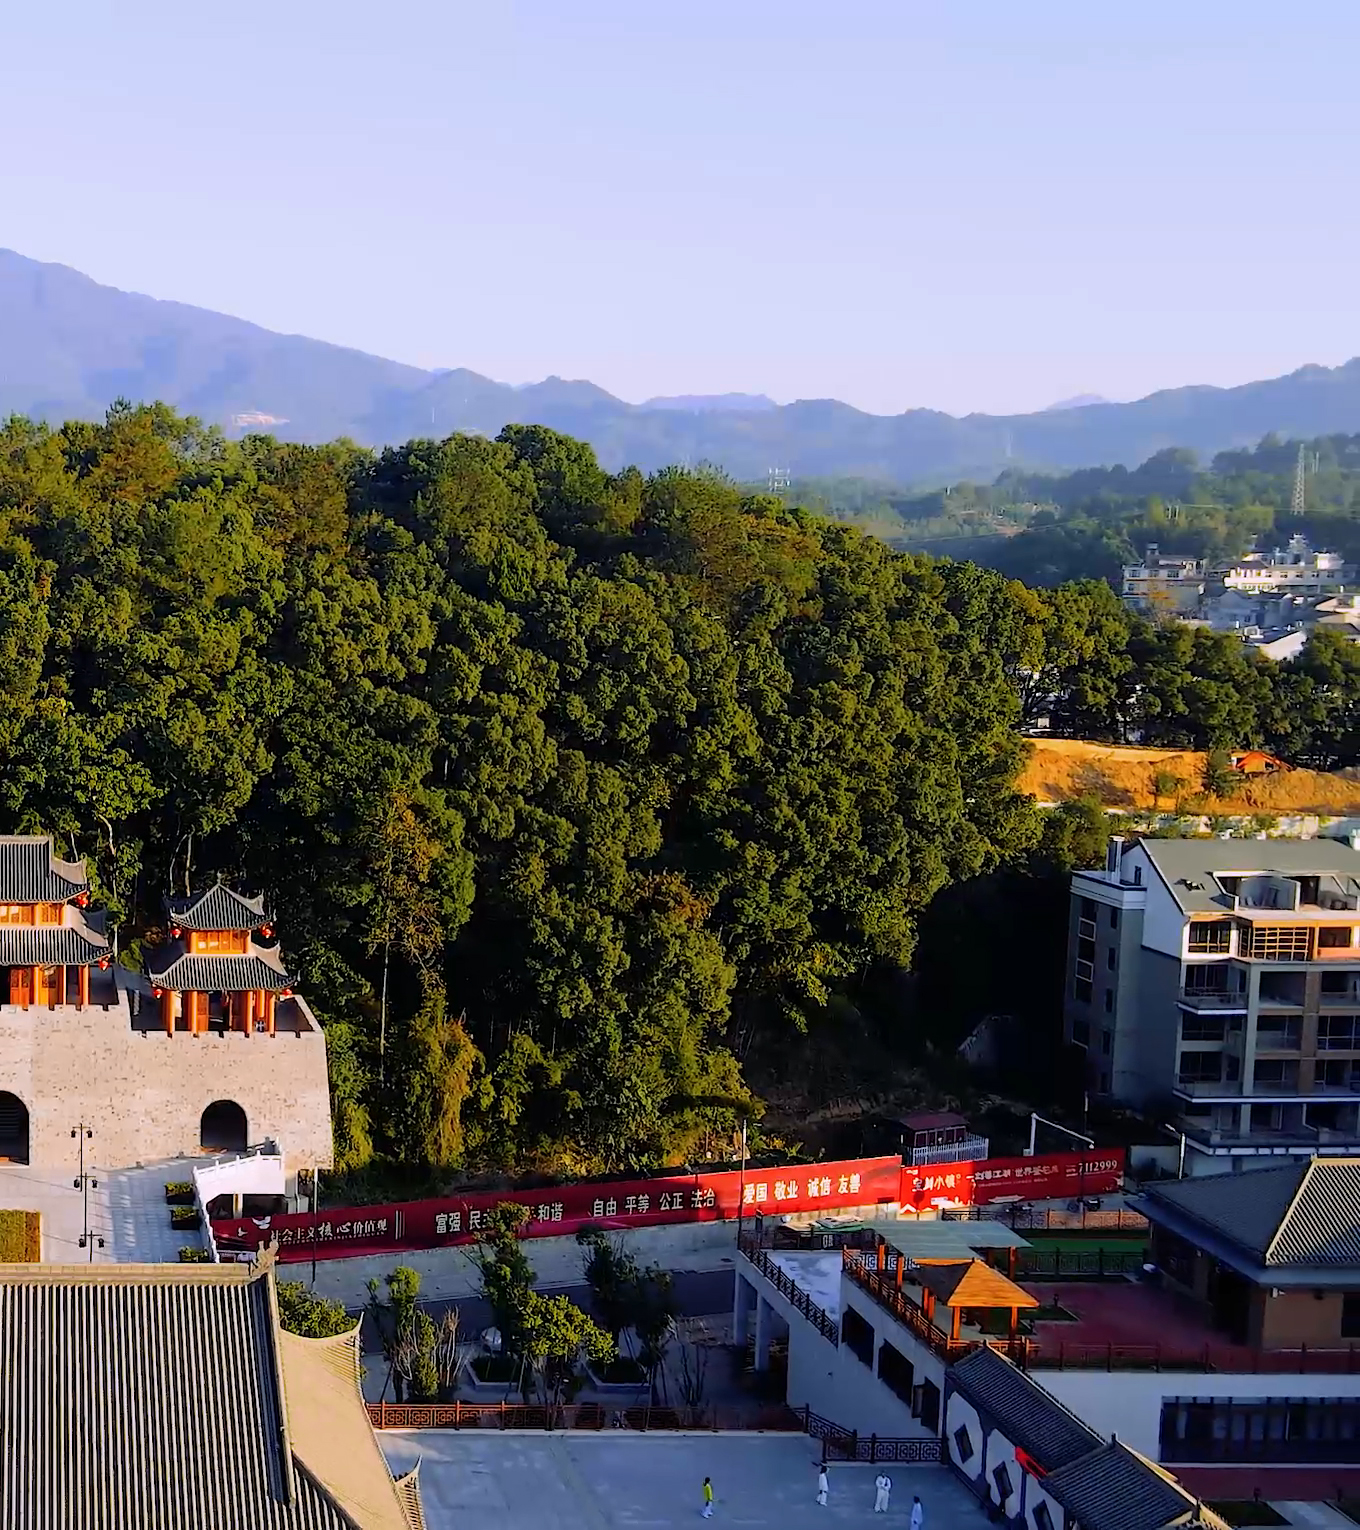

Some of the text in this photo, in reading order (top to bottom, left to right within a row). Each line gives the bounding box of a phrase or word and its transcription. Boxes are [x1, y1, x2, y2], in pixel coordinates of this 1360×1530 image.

[435, 1212, 461, 1234] 富强
[537, 1202, 564, 1223] 和谐
[593, 1197, 617, 1217] 自由
[625, 1193, 650, 1215] 平等
[659, 1192, 684, 1211] 公正
[691, 1187, 716, 1208] 法治
[743, 1182, 768, 1204] 爱国
[774, 1179, 799, 1201] 敬业
[807, 1175, 832, 1198] 诚信
[838, 1172, 861, 1194] 友善
